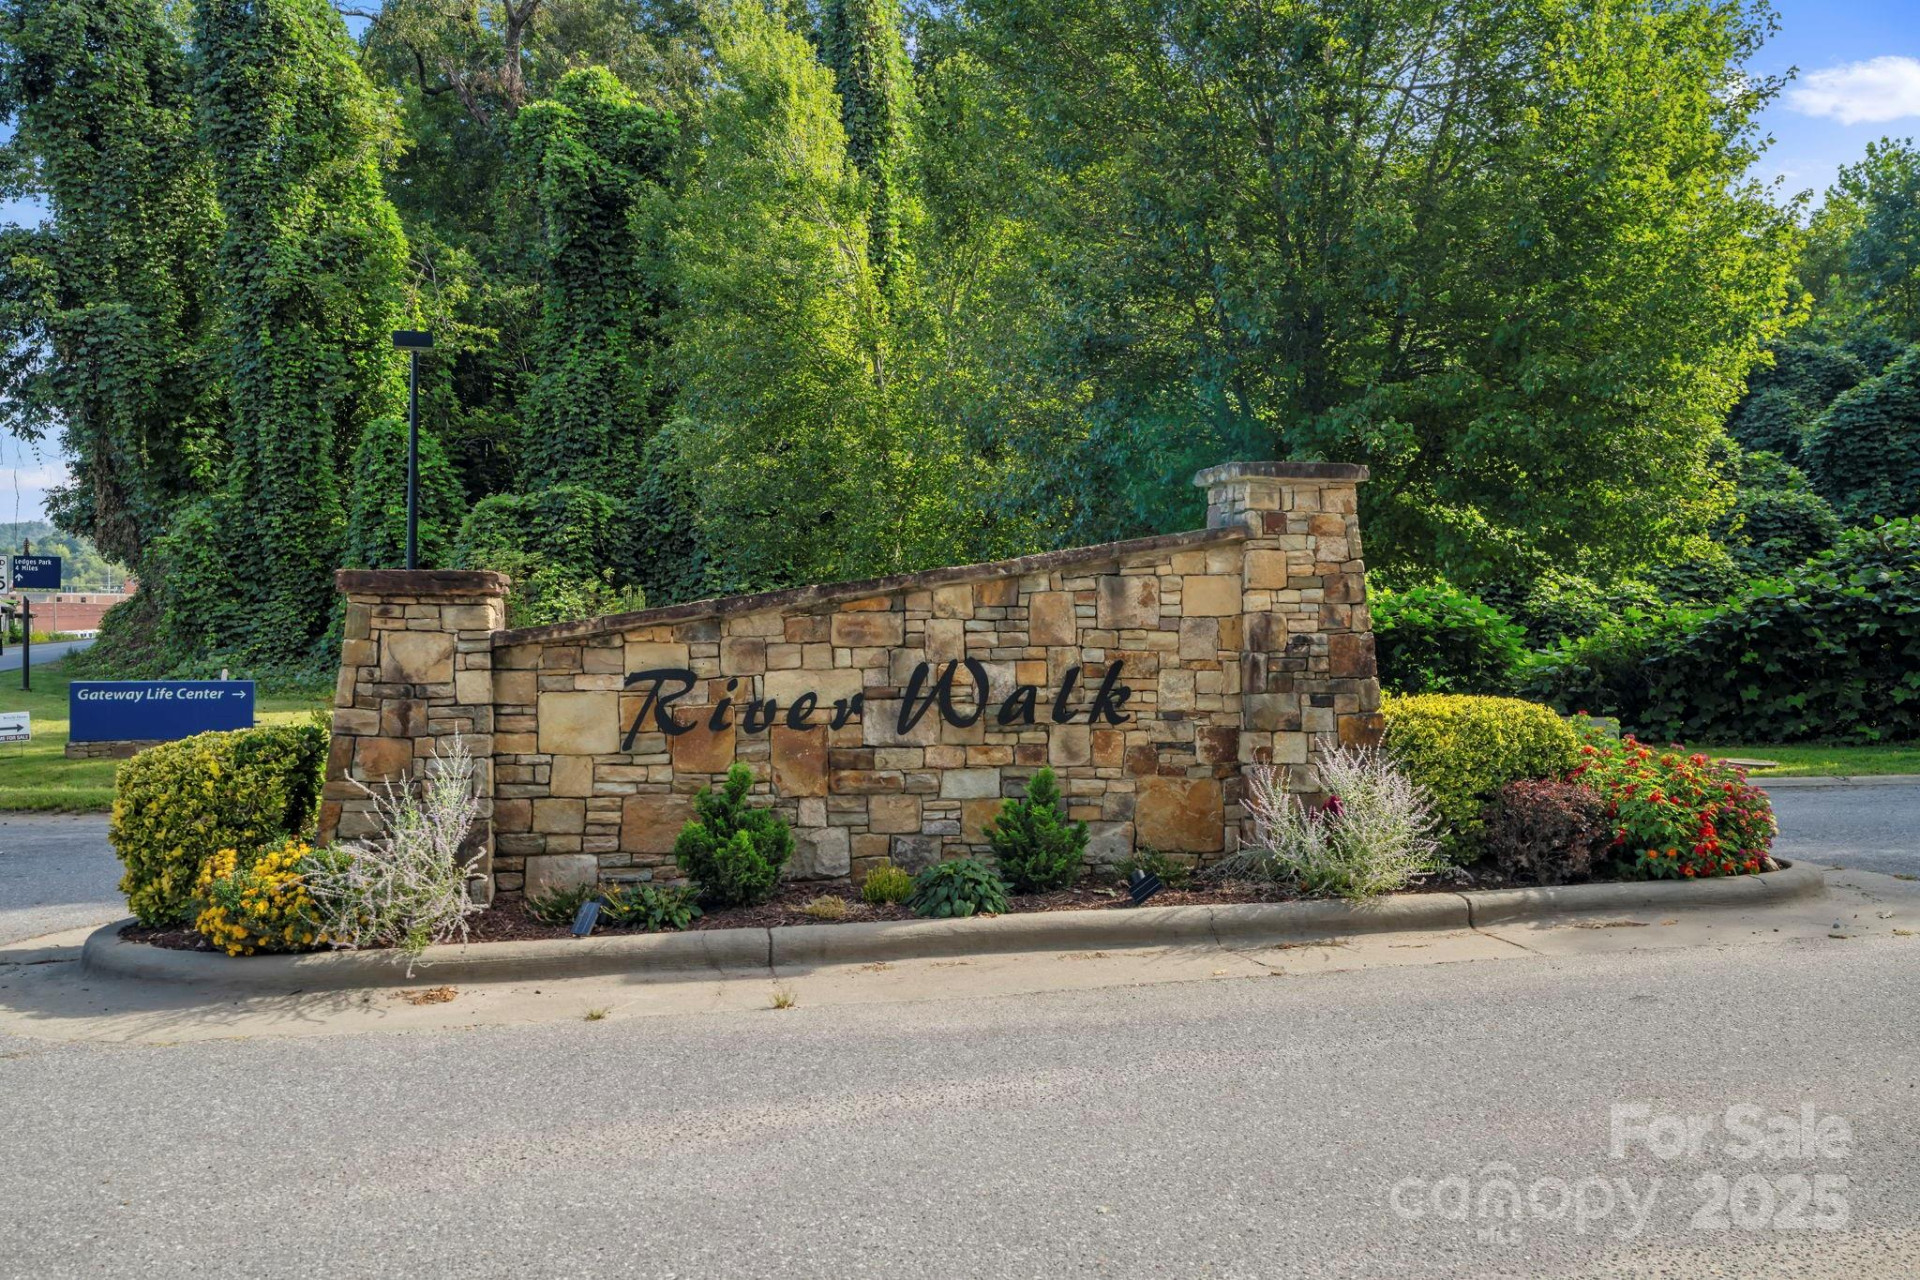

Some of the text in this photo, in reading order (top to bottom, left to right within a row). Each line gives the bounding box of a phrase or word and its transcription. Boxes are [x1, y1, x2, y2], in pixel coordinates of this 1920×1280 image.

[15, 558, 37, 566] Ledges
[77, 688, 224, 703] Gateway Life Center
[621, 656, 1132, 752] River Walk
